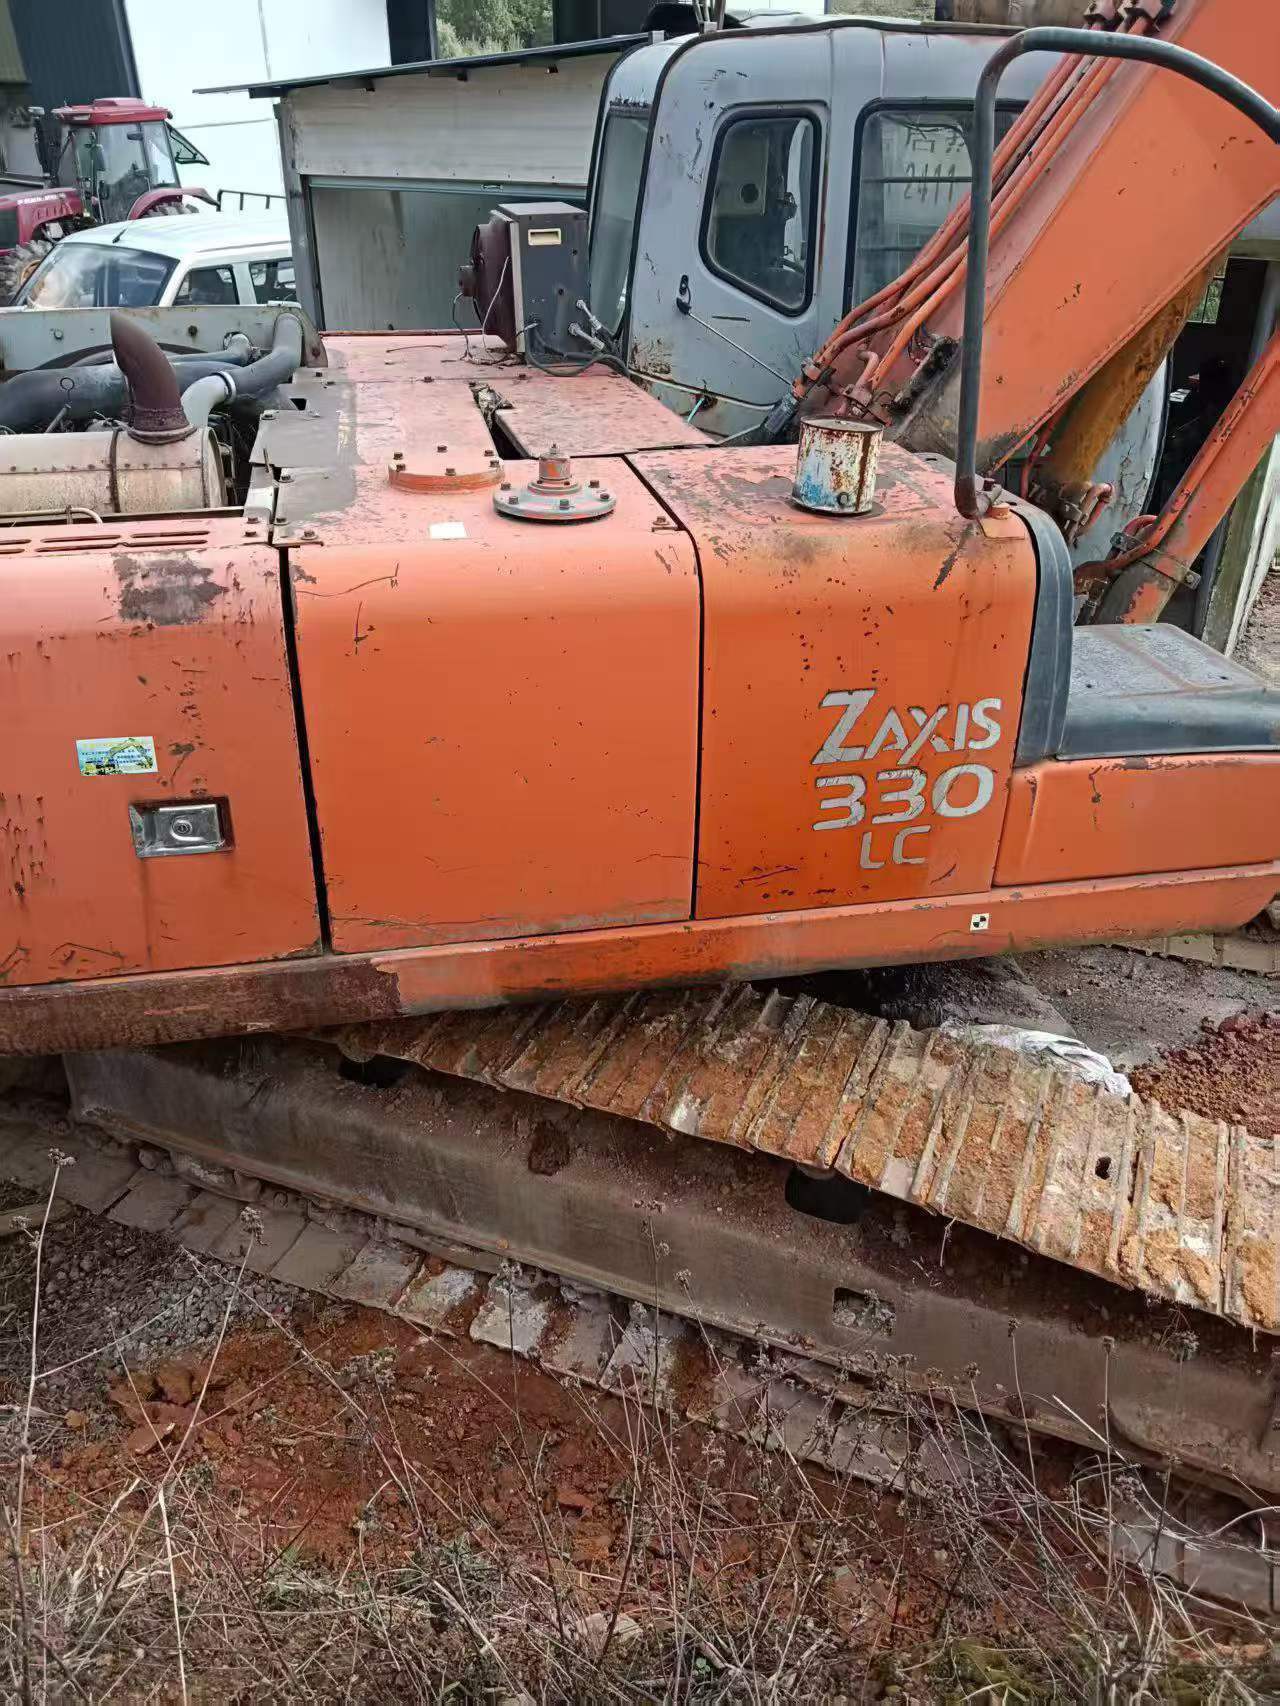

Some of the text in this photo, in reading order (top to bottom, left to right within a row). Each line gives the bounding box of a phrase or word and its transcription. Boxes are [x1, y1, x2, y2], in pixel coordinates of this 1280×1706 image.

[811, 688, 1002, 765] ZAXIS
[812, 763, 994, 831] 330
[859, 825, 931, 869] LC
